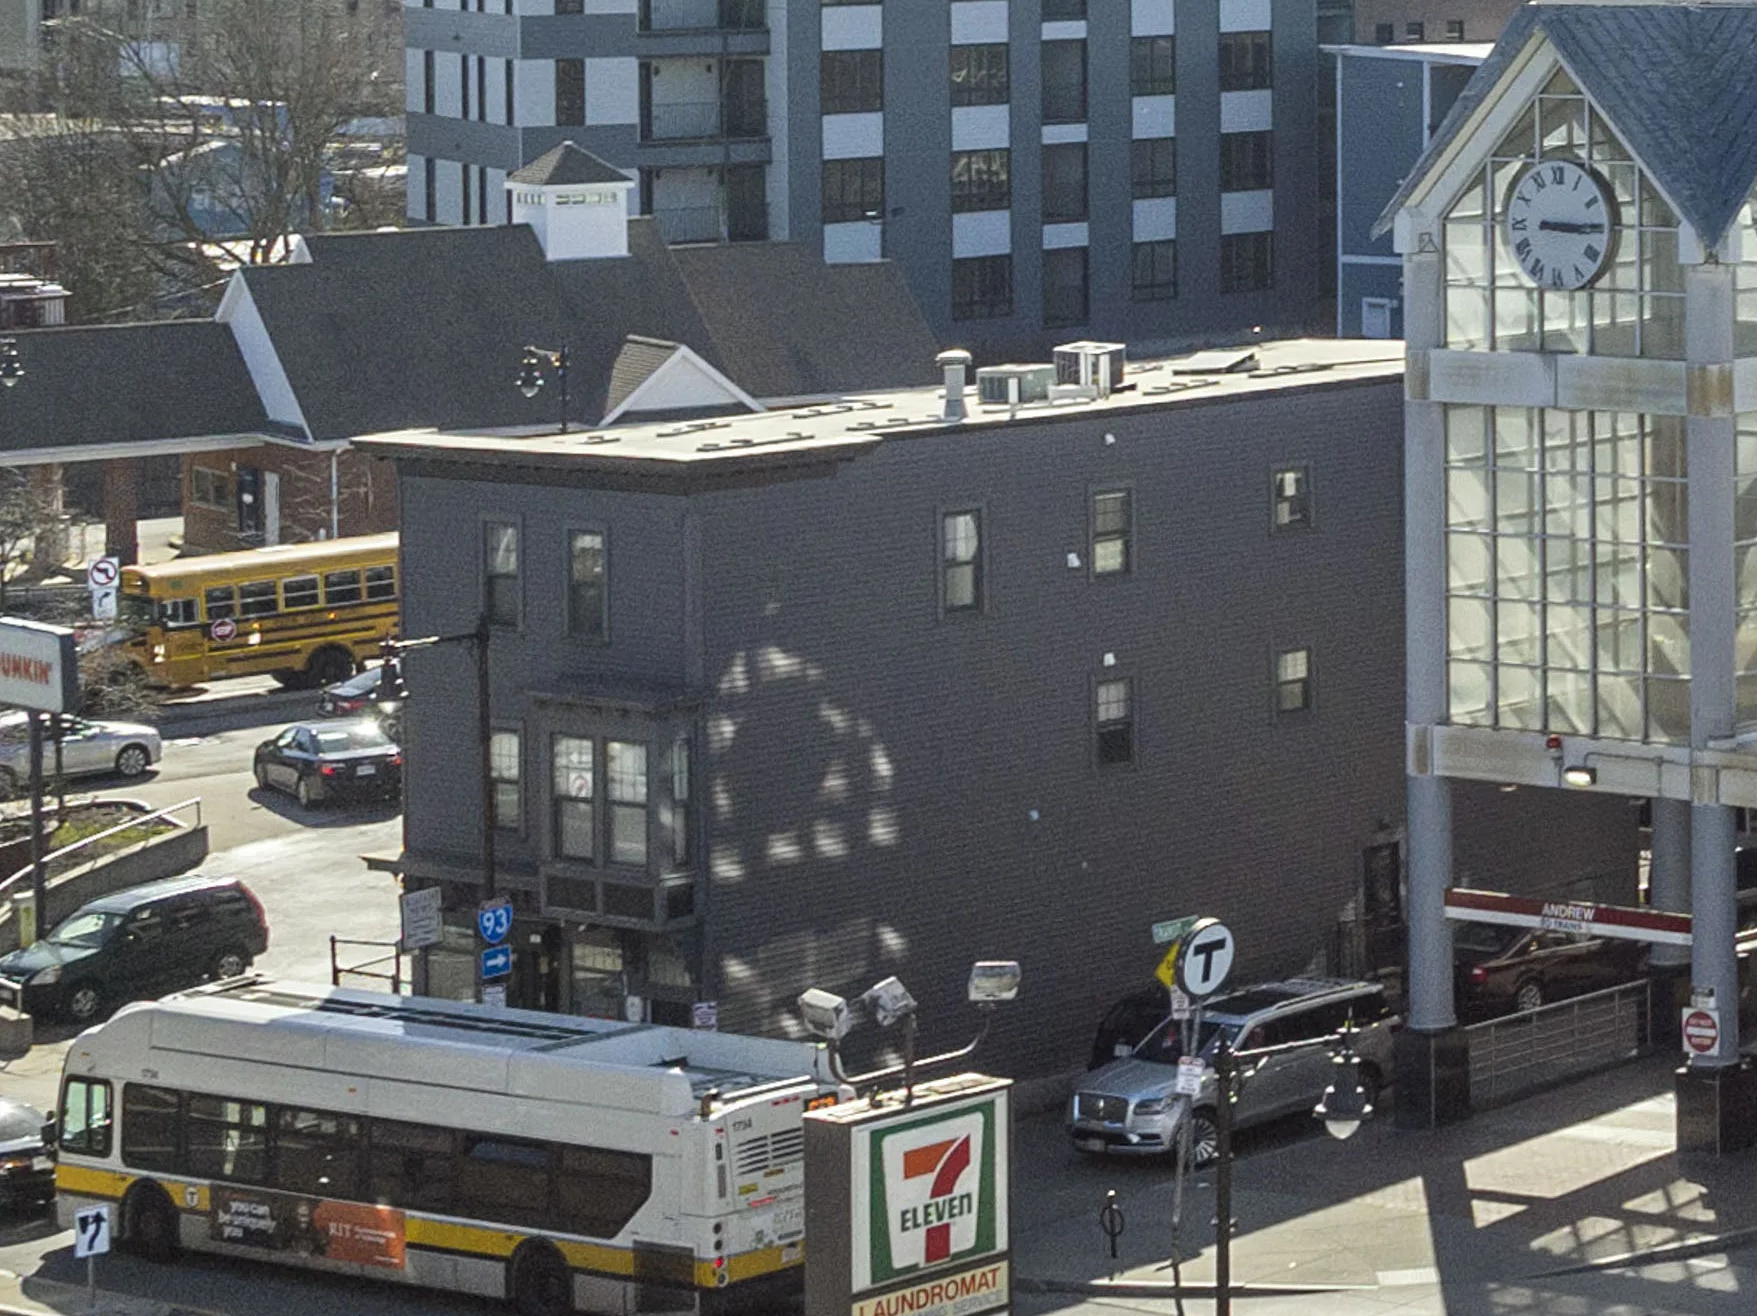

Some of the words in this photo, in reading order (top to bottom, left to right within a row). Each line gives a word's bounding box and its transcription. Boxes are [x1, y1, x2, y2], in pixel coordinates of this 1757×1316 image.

[483, 908, 508, 936] 93
[1541, 902, 1596, 921] ANDREW
[1193, 936, 1227, 984] T
[903, 1134, 971, 1263] 7
[953, 1290, 1004, 1316] SERVICE
